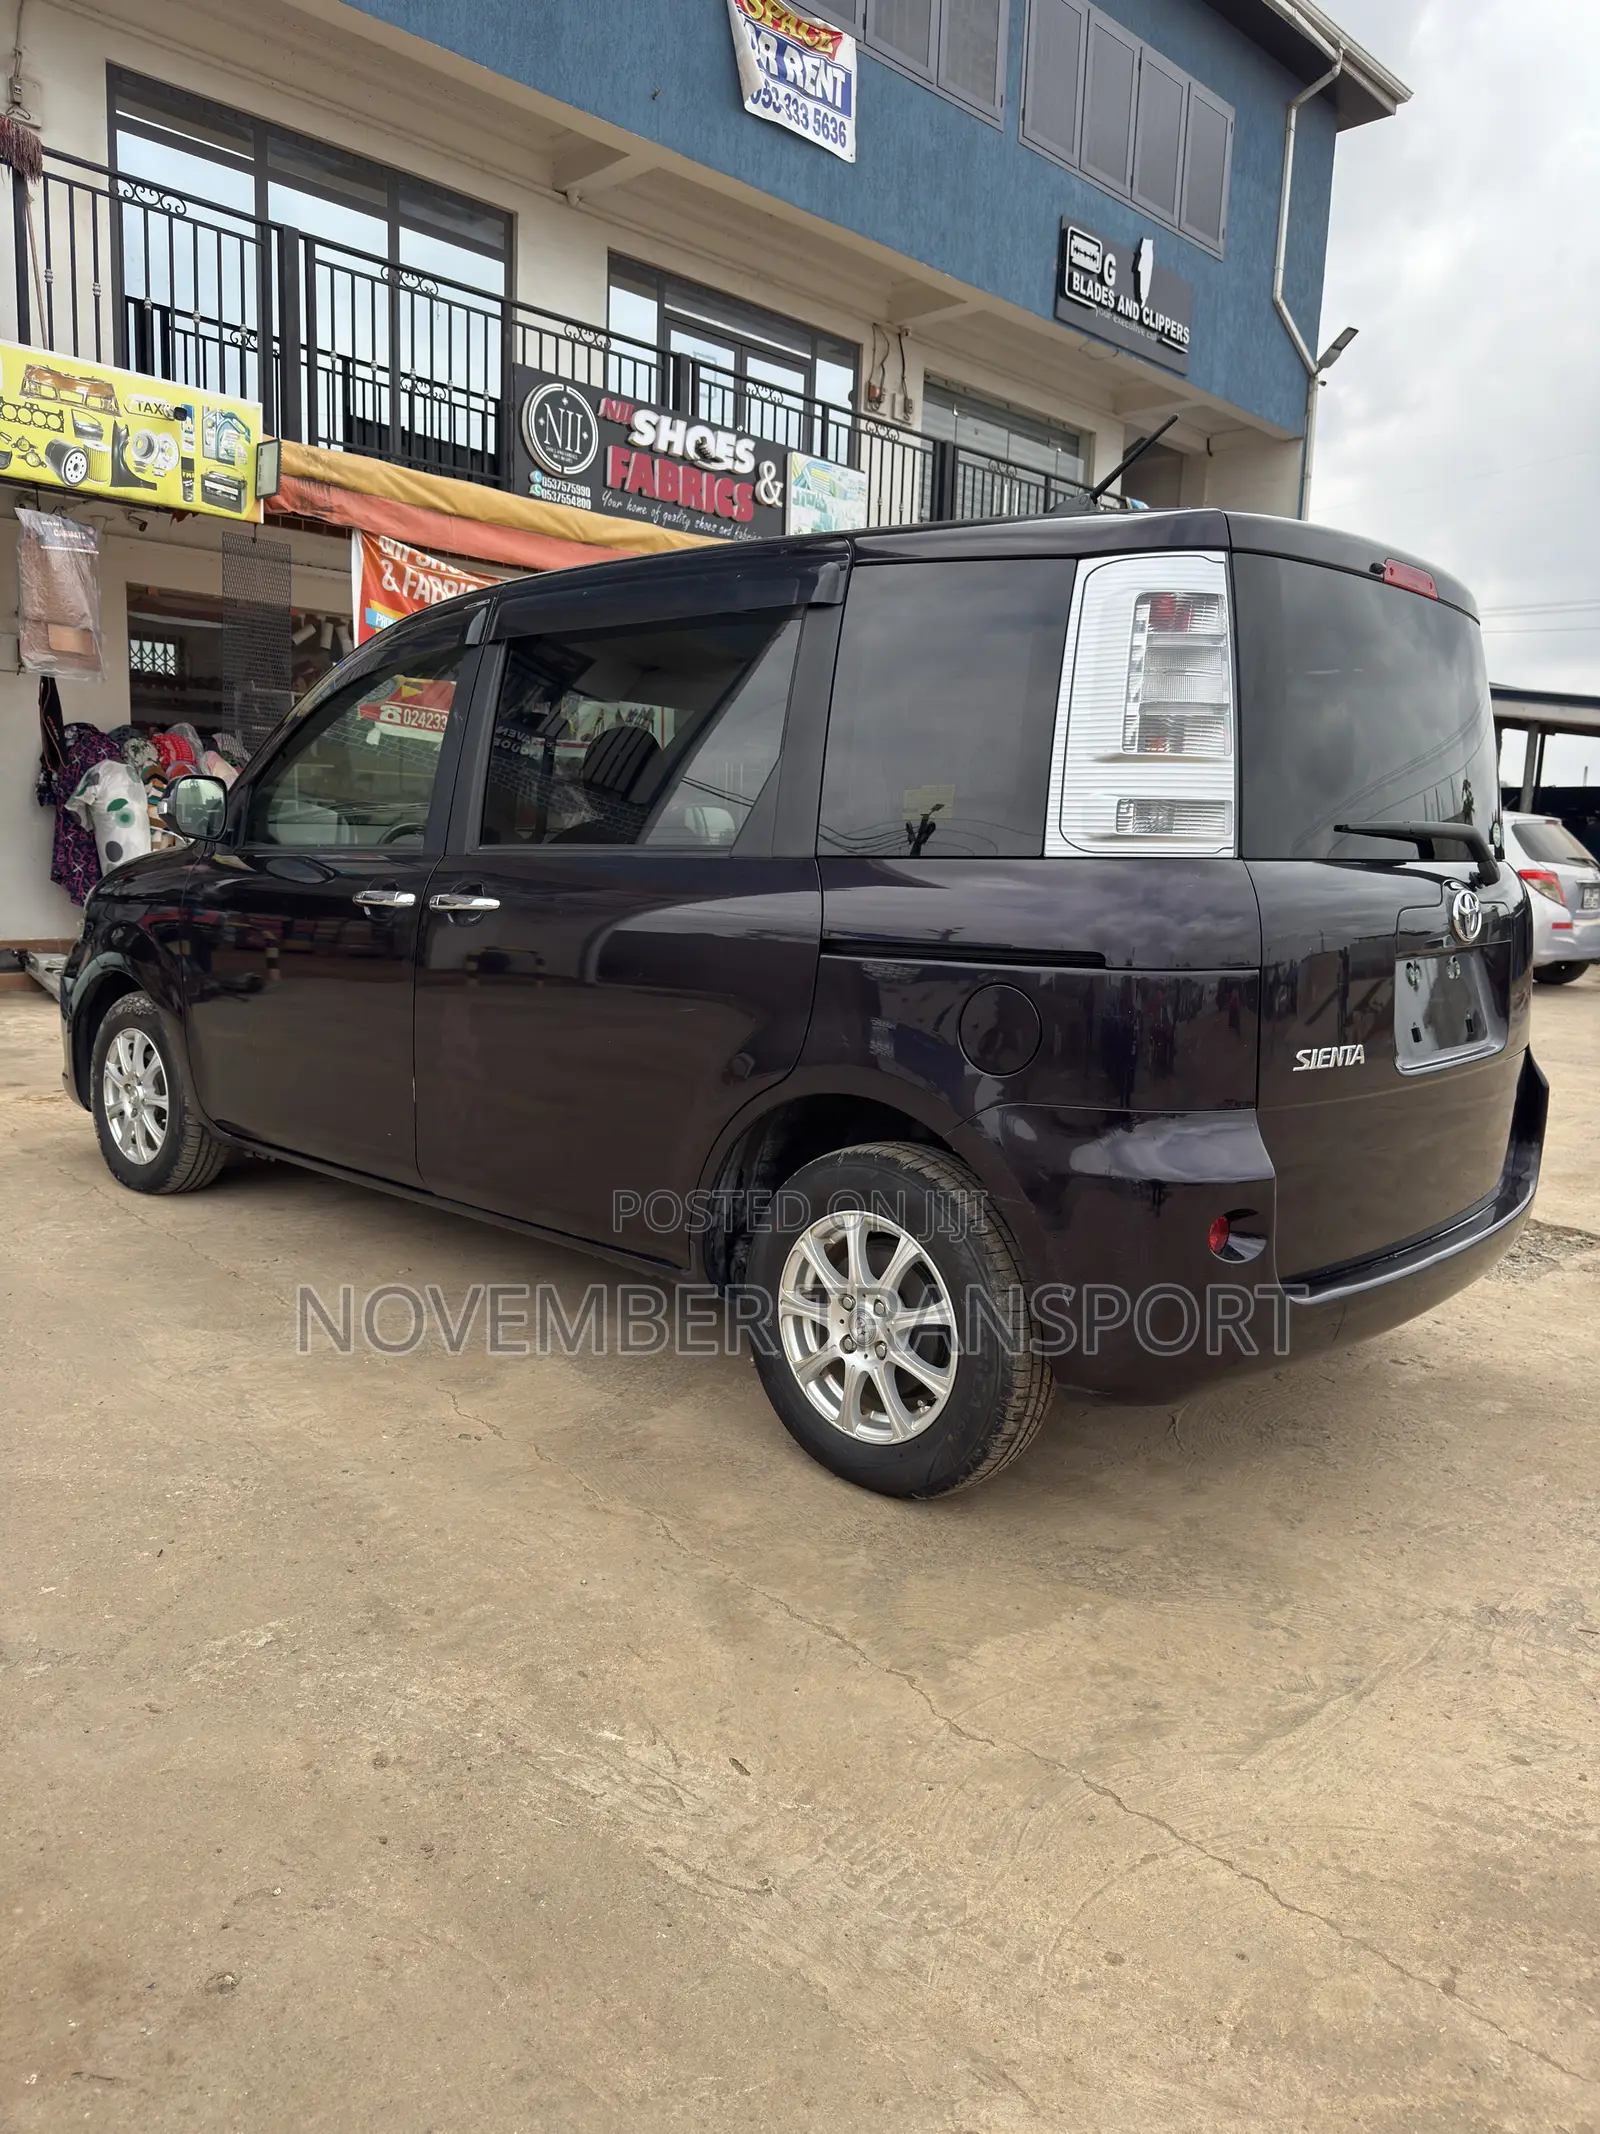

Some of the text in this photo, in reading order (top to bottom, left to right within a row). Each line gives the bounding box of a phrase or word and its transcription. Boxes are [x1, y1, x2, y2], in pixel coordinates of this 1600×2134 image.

[743, 0, 834, 54] SPACE
[744, 19, 846, 109] OR RENT
[813, 108, 847, 148] 5636
[1103, 253, 1117, 286] G
[1072, 271, 1190, 345] BLADES AND CLIPPERS
[543, 403, 583, 454] NII
[598, 397, 755, 474] NII SHOES
[541, 476, 591, 498] 0537575990
[541, 488, 592, 511] 0537554800
[607, 445, 783, 523] FABRICS &
[602, 490, 622, 507] Your
[626, 498, 647, 515] home
[651, 504, 662, 523] of
[663, 509, 691, 532] quality
[694, 516, 717, 533] shoes
[719, 524, 734, 536] and
[381, 559, 401, 594] &
[1292, 1044, 1365, 1072] SIENTA
